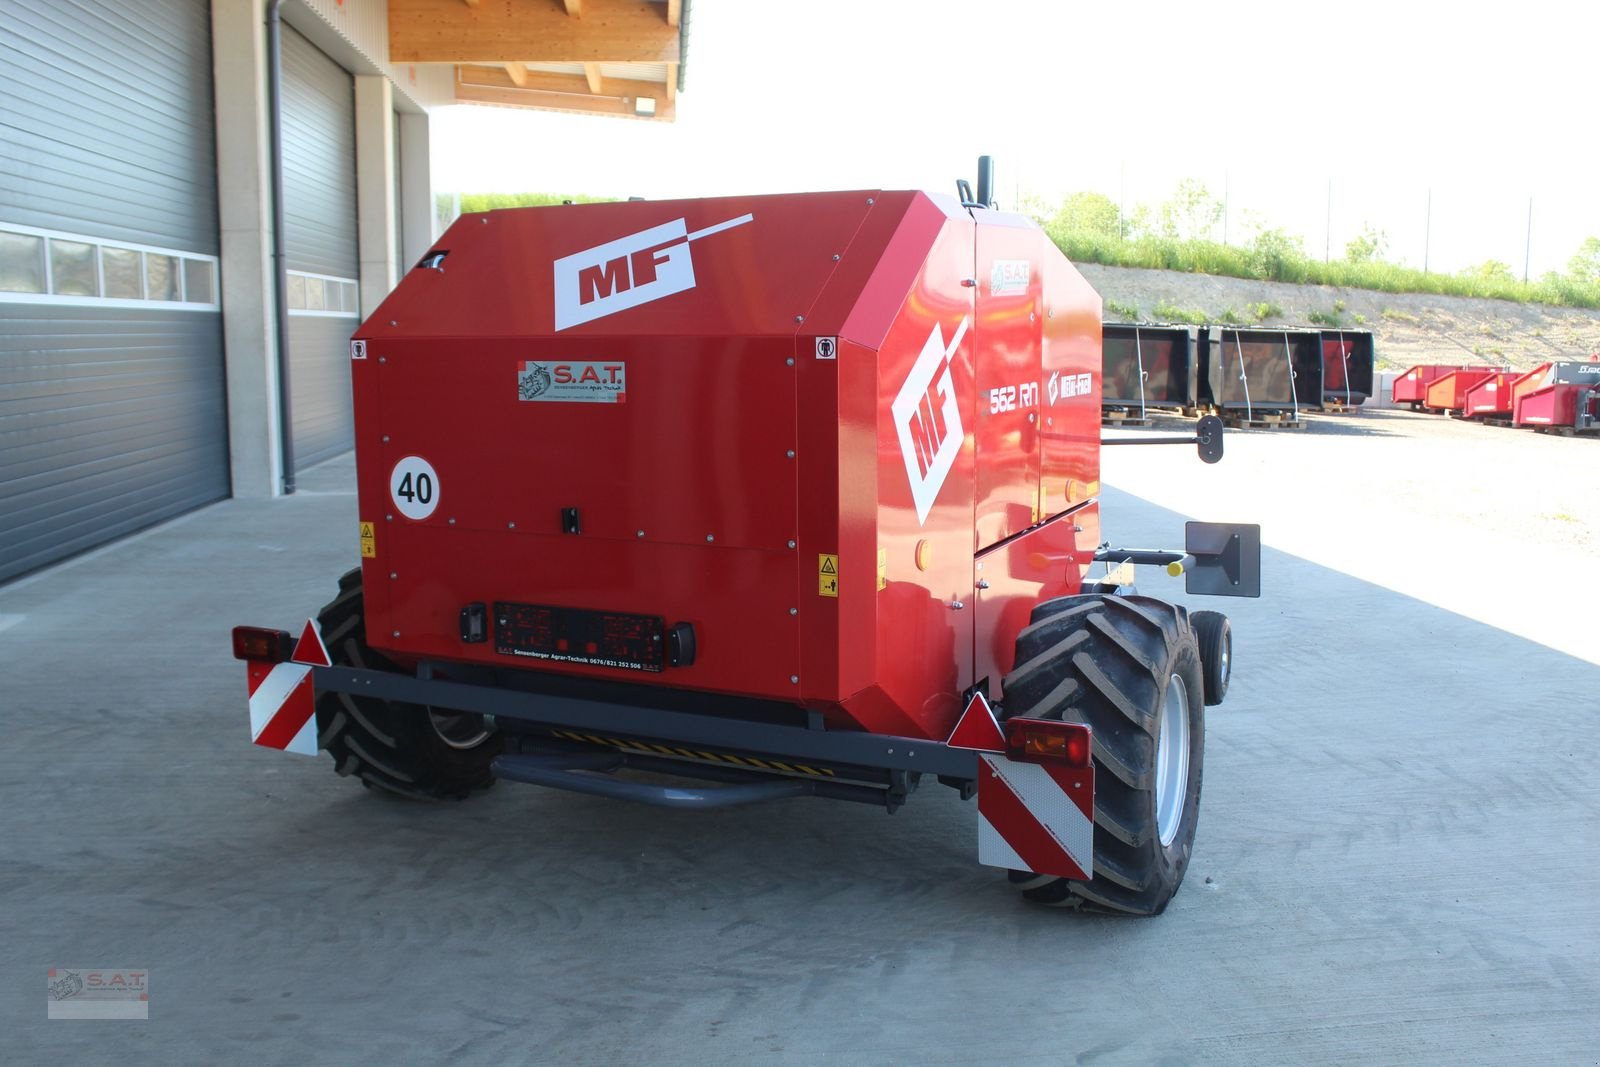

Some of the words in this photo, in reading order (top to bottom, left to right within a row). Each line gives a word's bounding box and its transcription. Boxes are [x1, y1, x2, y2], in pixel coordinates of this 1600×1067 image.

[579, 236, 688, 305] MF
[553, 365, 622, 384] S.A.T.
[990, 385, 1016, 415] 562
[908, 352, 949, 482] MF
[398, 471, 432, 504] 40
[514, 649, 549, 659] Sensenberger
